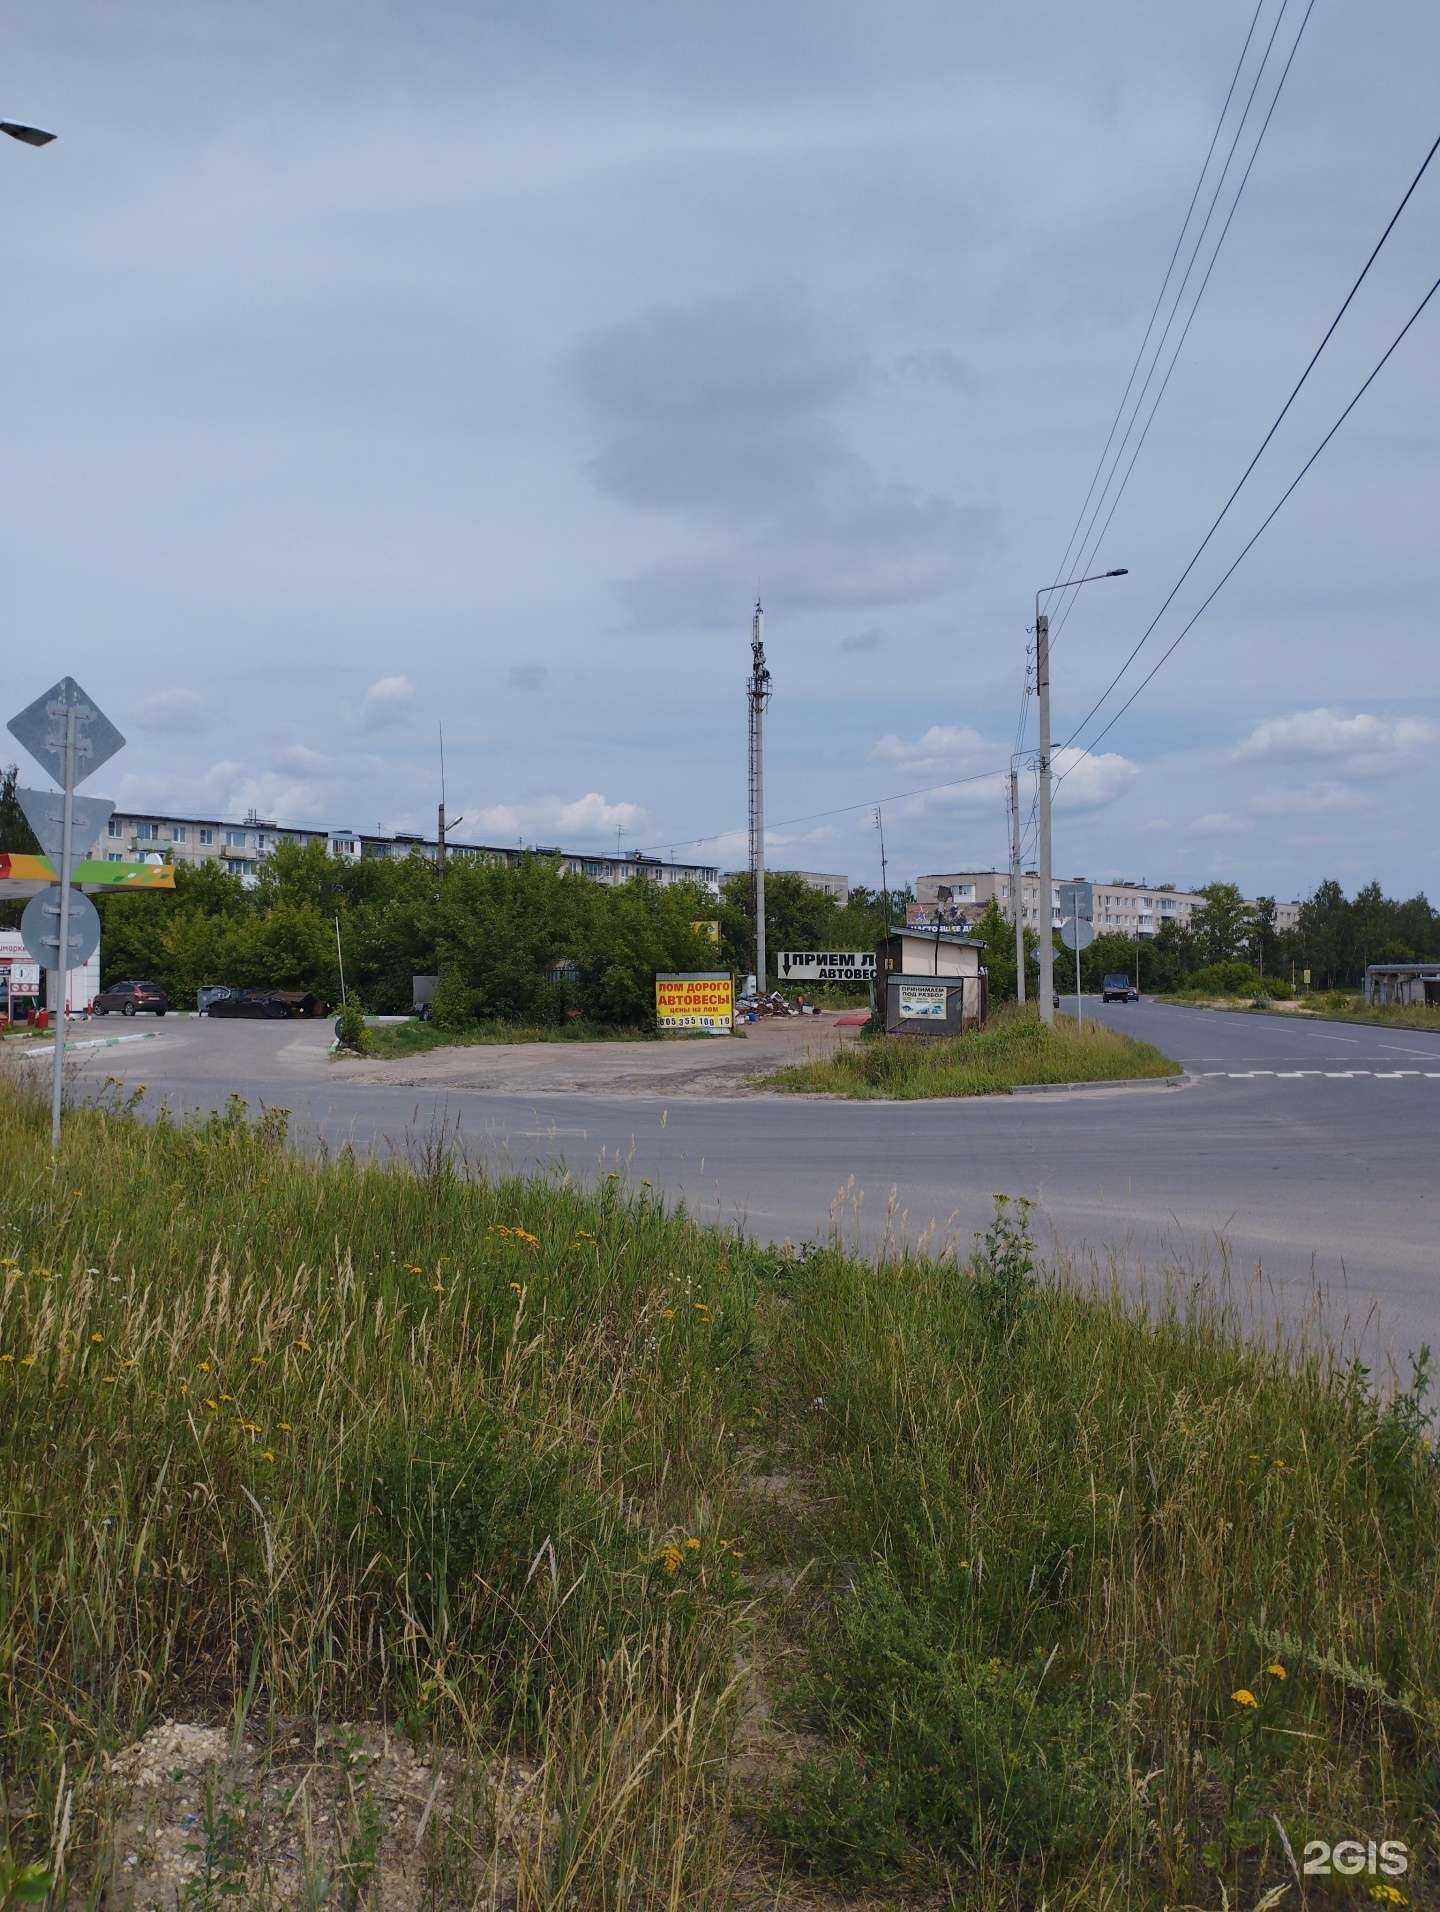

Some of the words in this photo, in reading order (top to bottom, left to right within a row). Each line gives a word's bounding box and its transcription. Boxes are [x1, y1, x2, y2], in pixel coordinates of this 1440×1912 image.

[792, 953, 855, 966] ПРИЕМ
[658, 983, 684, 992] ЛОМ
[687, 982, 730, 993] ДОРОГО
[658, 994, 730, 1005] АВТОВЕСЫ
